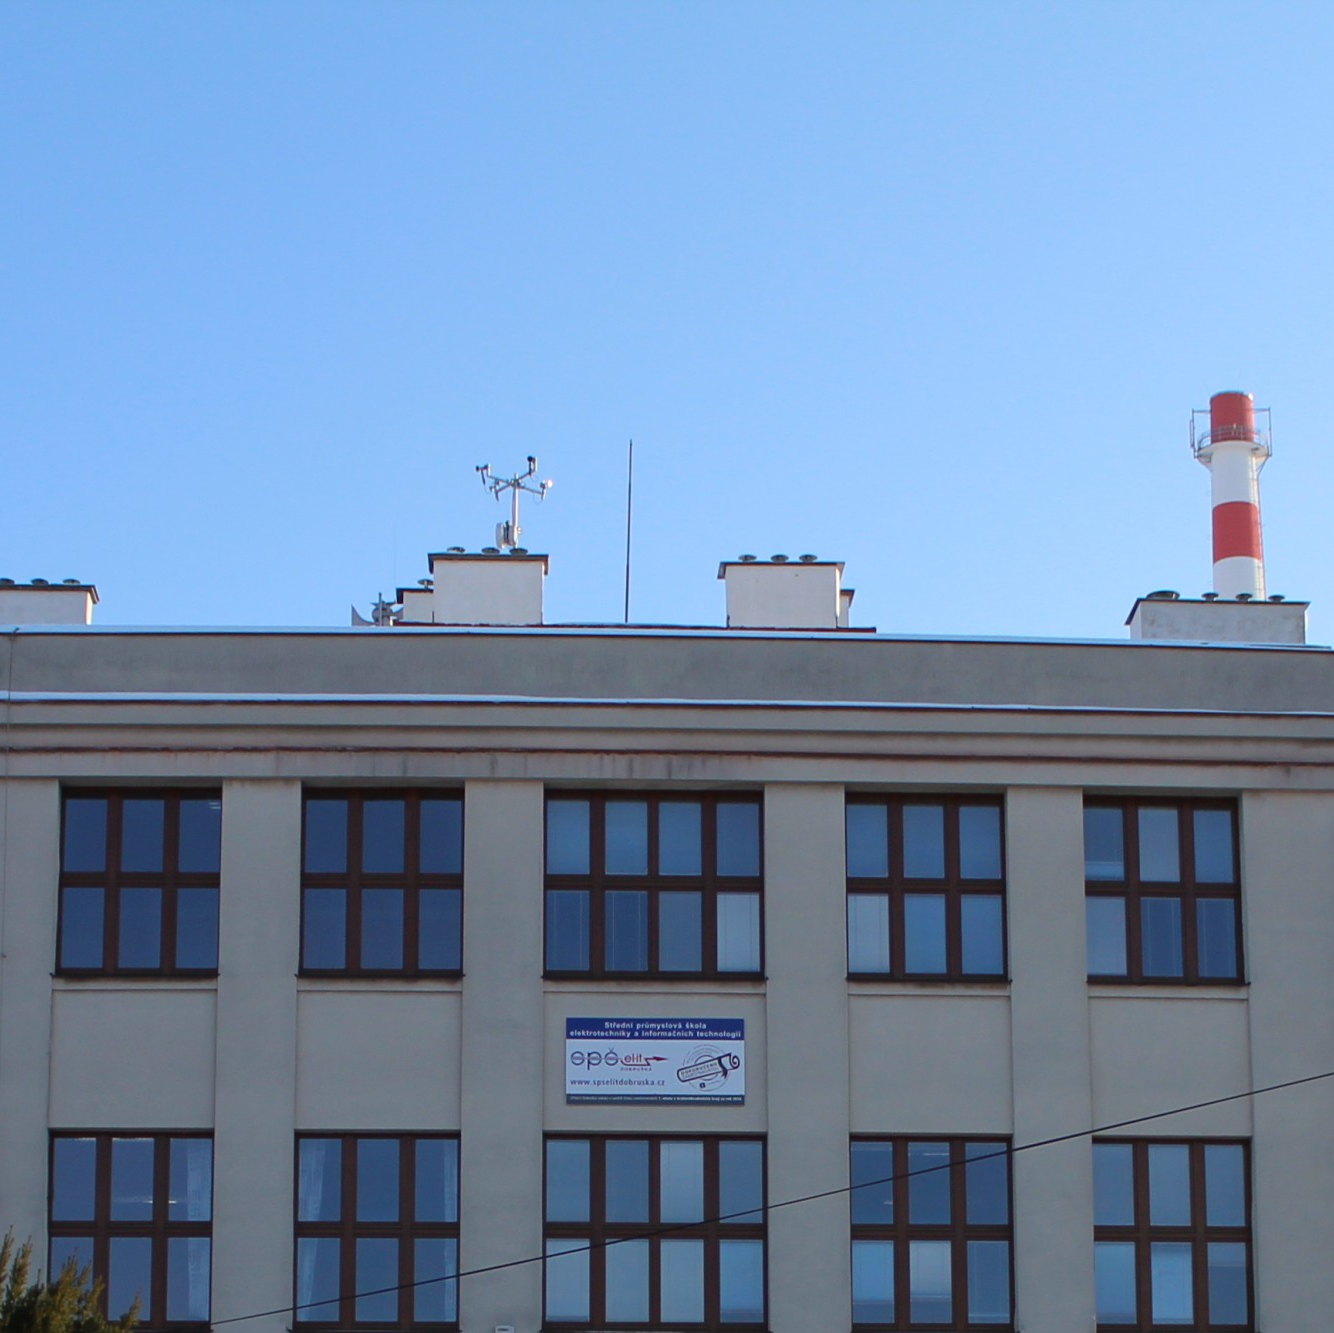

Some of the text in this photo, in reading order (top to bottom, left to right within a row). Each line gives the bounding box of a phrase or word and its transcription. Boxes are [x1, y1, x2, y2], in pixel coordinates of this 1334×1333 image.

[604, 1021, 707, 1031] Střední průmyslová škola
[569, 1030, 631, 1038] elektrotechniky
[570, 1078, 666, 1087] www.spselitdobruska.cz
